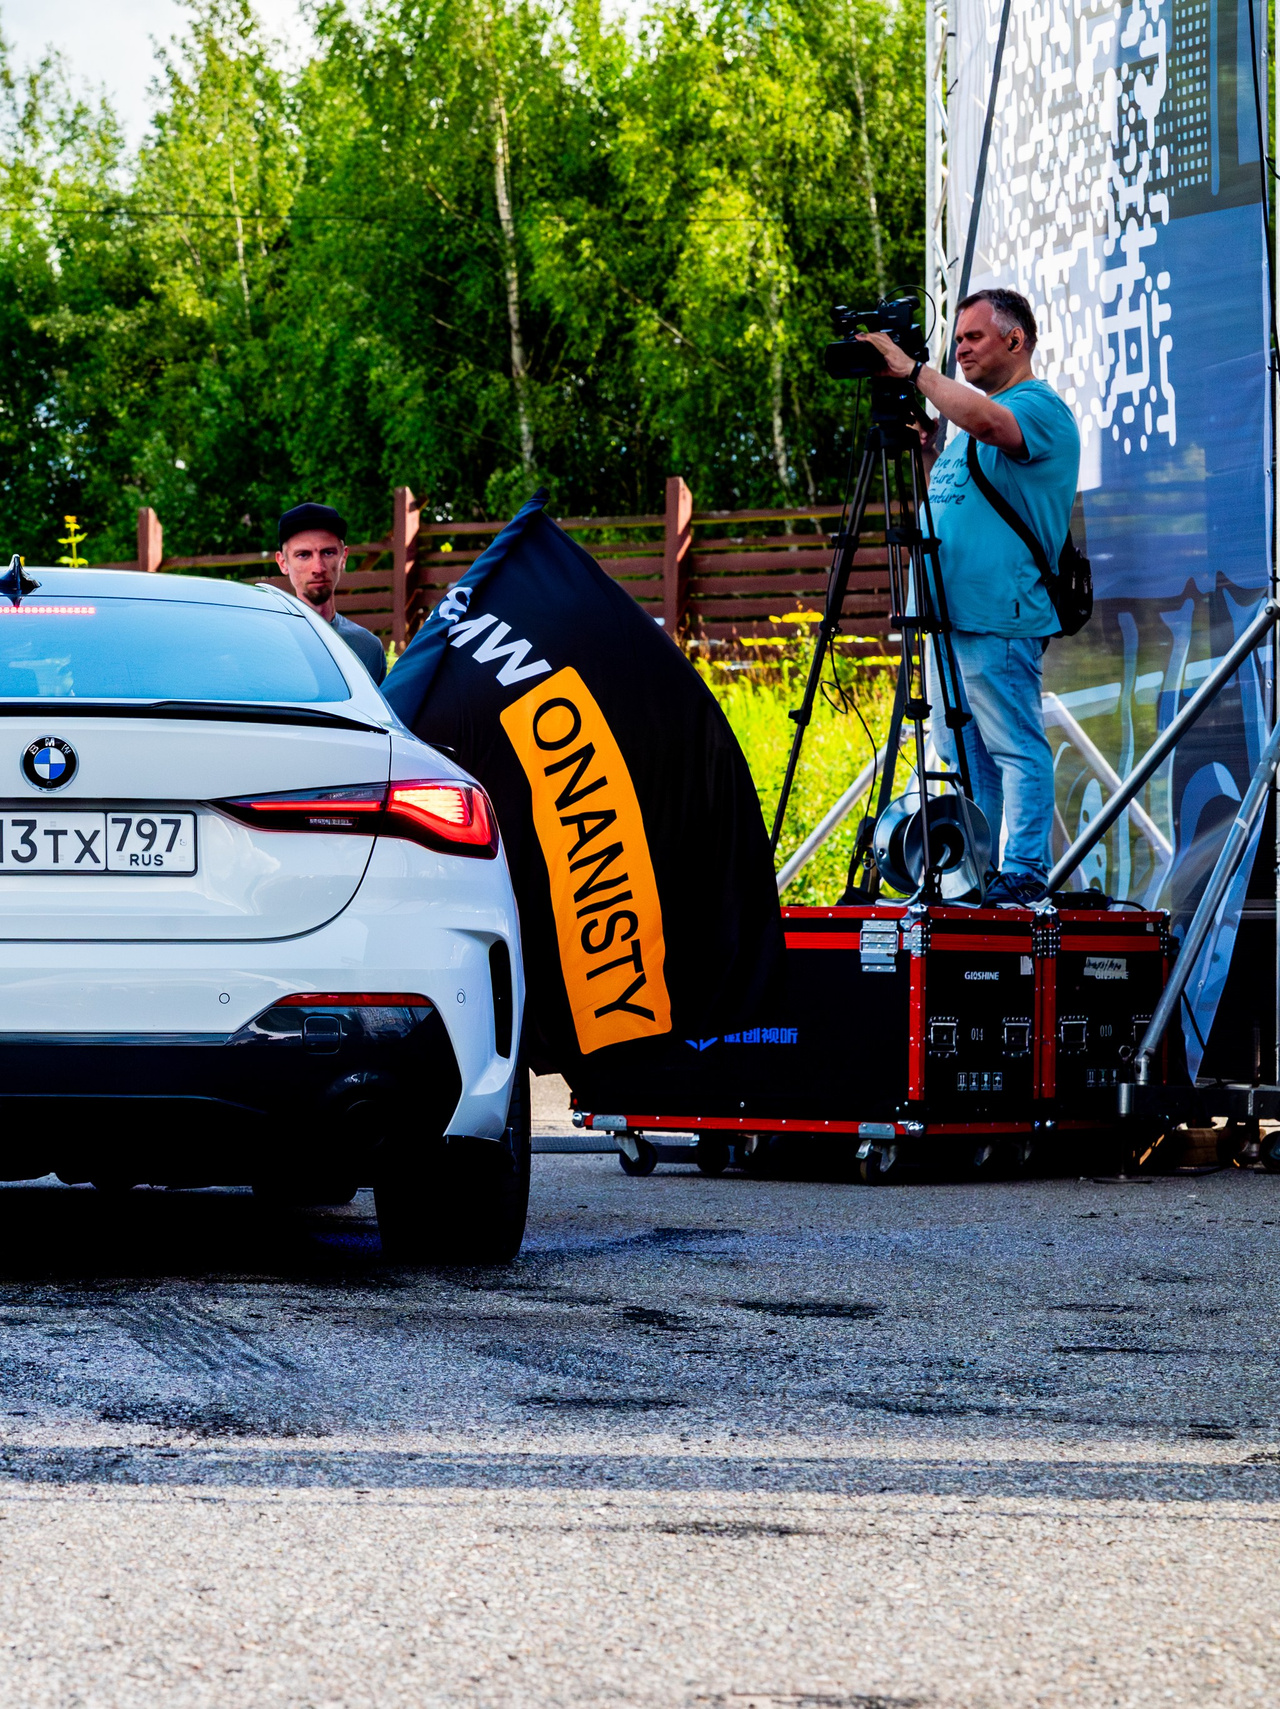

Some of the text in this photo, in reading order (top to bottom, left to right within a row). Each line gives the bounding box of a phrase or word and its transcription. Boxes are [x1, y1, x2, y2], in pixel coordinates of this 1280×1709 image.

[28, 737, 72, 755] BMW
[111, 817, 182, 852] 797
[129, 853, 164, 867] RUS
[532, 697, 657, 1023] ONANISTY
